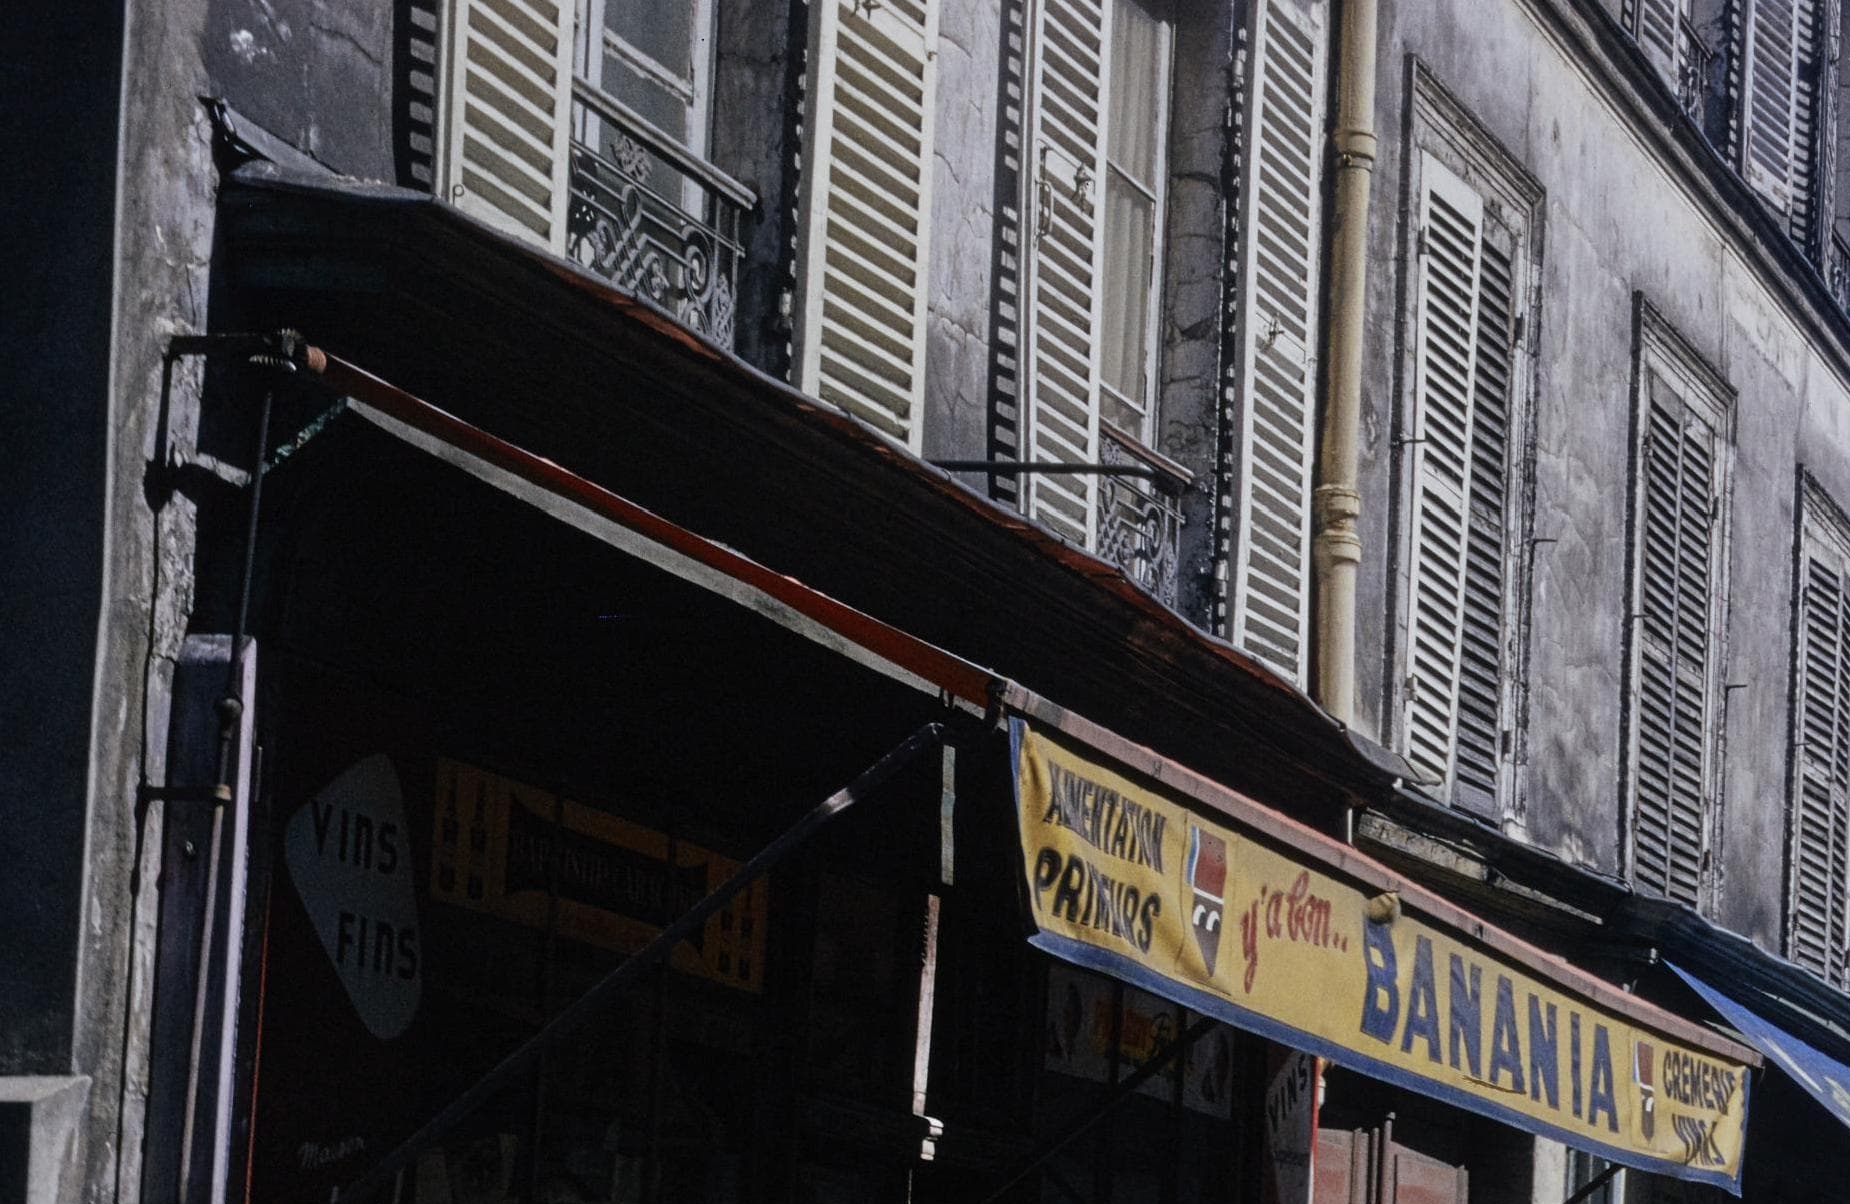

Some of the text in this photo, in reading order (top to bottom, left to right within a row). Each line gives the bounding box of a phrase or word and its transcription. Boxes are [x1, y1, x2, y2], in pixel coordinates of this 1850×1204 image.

[1043, 760, 1166, 875] AMENTATION
[1034, 847, 1160, 955] PRIMURS
[1360, 914, 1618, 1135] BANANIA
